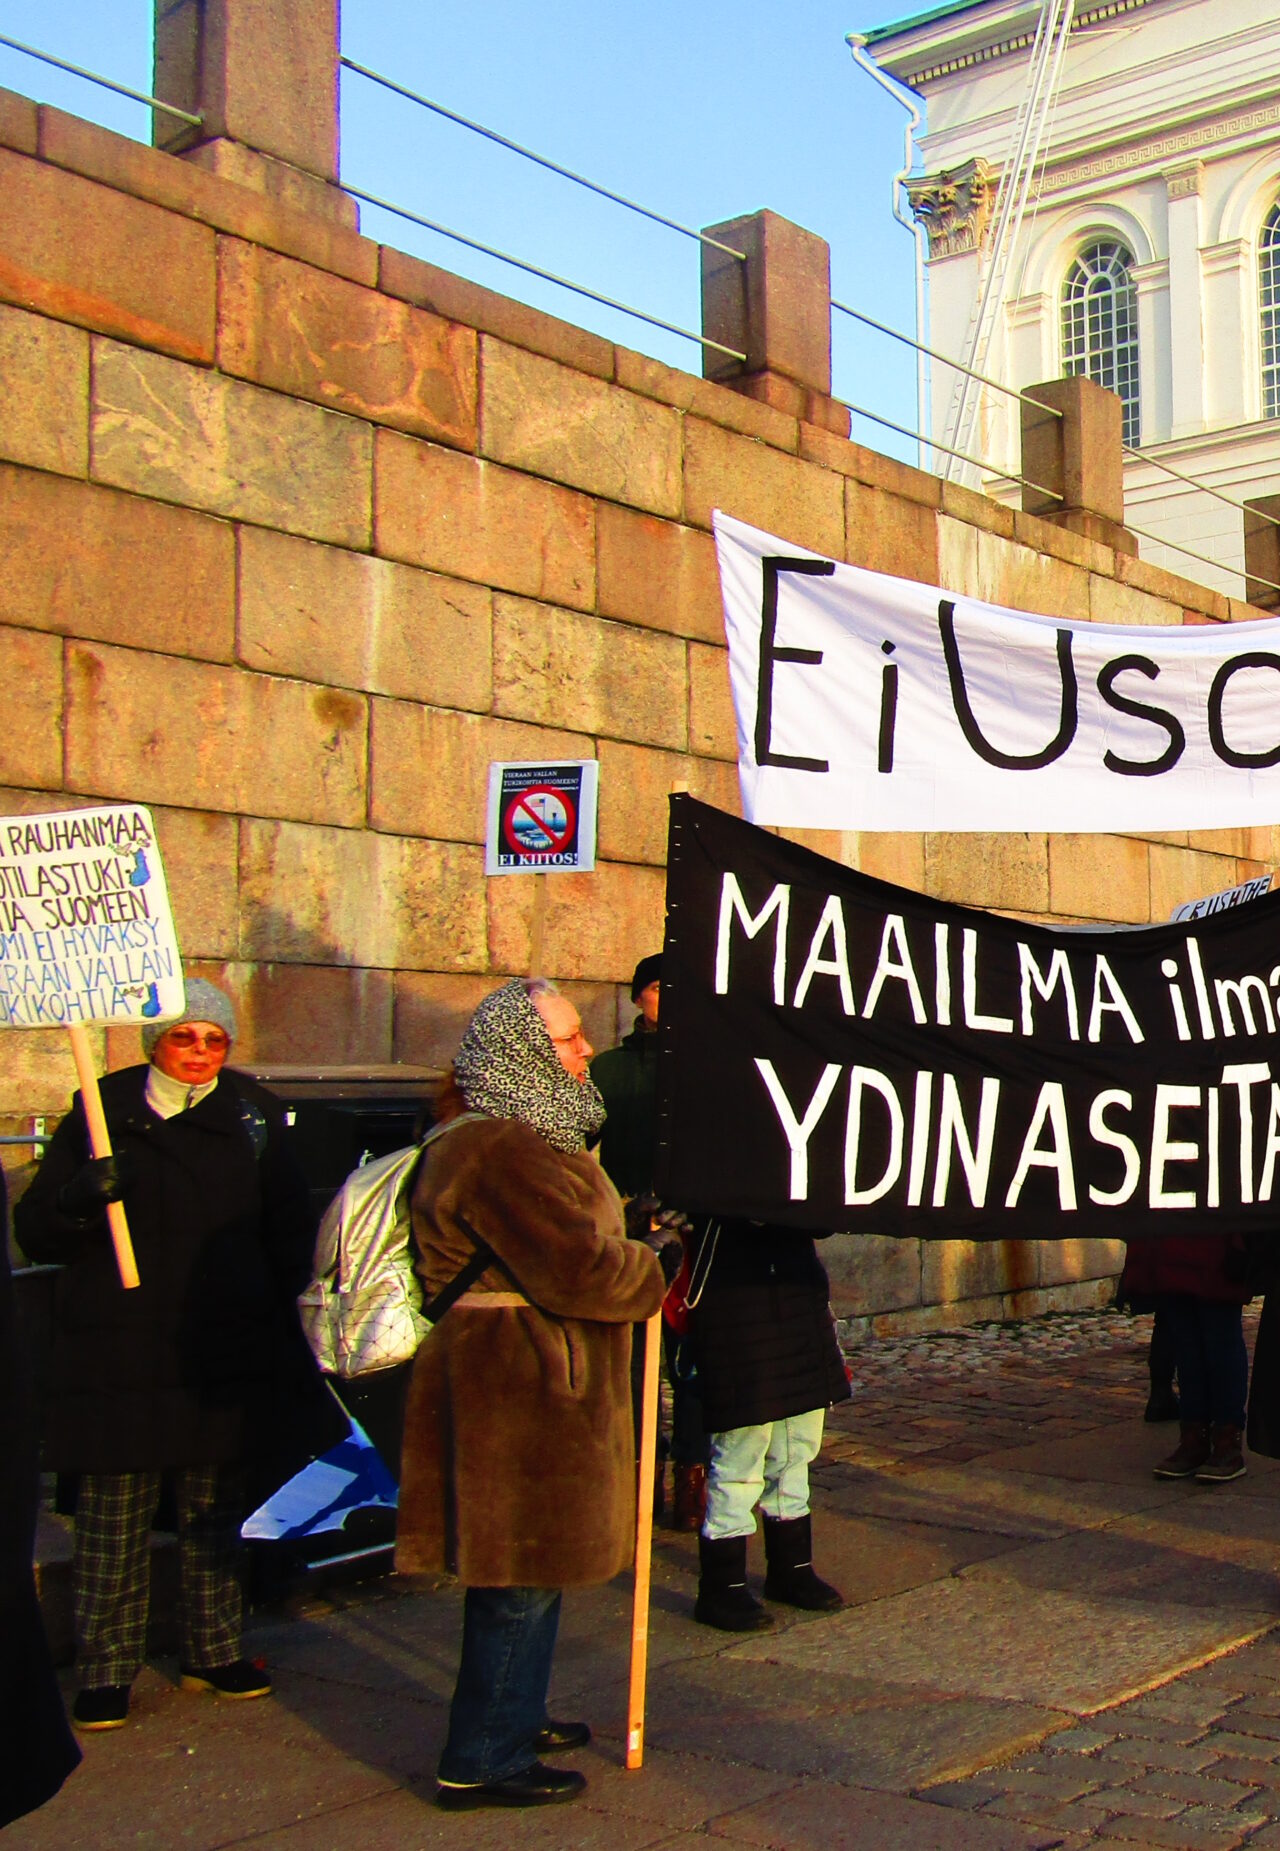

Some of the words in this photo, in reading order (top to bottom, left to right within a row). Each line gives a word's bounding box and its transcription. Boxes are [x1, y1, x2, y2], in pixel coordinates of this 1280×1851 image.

[754, 556, 899, 773] Ei
[7, 812, 152, 856] RAUHANMAA
[500, 853, 516, 866] EI
[519, 852, 579, 866] KIITOS!
[41, 888, 151, 931] SUOMEEN
[33, 930, 56, 962] EI
[714, 872, 1145, 1044] MAAILMA
[76, 947, 174, 989] VALLAN
